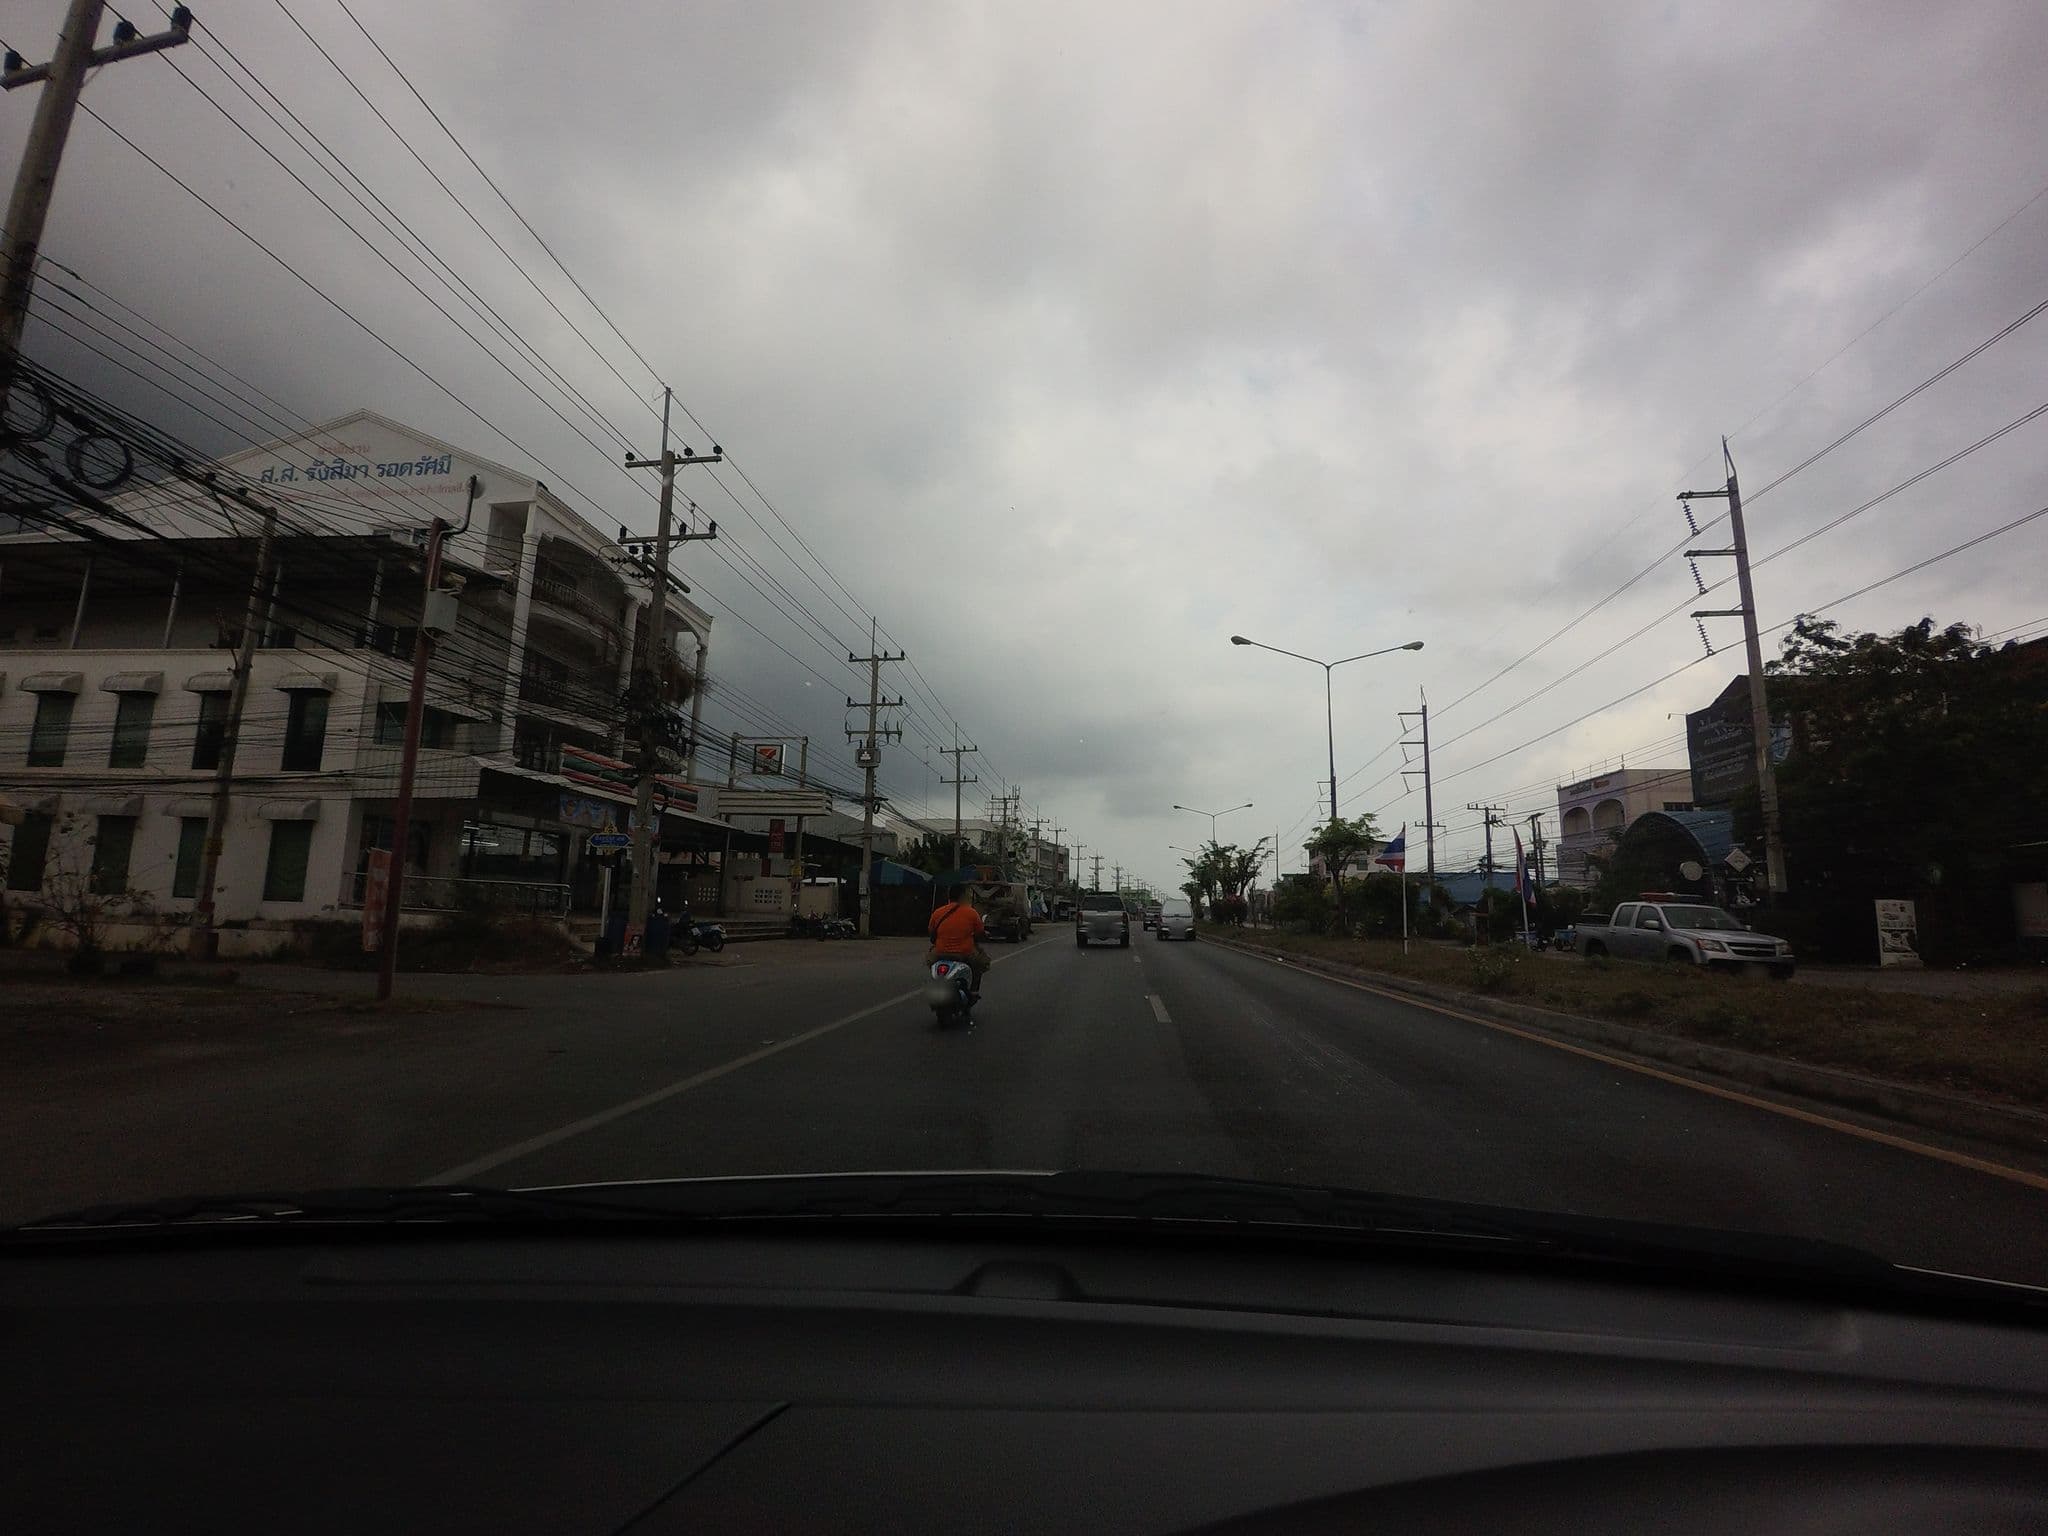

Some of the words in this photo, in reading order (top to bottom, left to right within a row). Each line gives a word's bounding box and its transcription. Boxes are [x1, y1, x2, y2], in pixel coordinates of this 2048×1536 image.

[261, 464, 299, 483] ส.ส.
[307, 458, 369, 481] รังสิมา
[376, 454, 452, 478] รอดรัศมี
